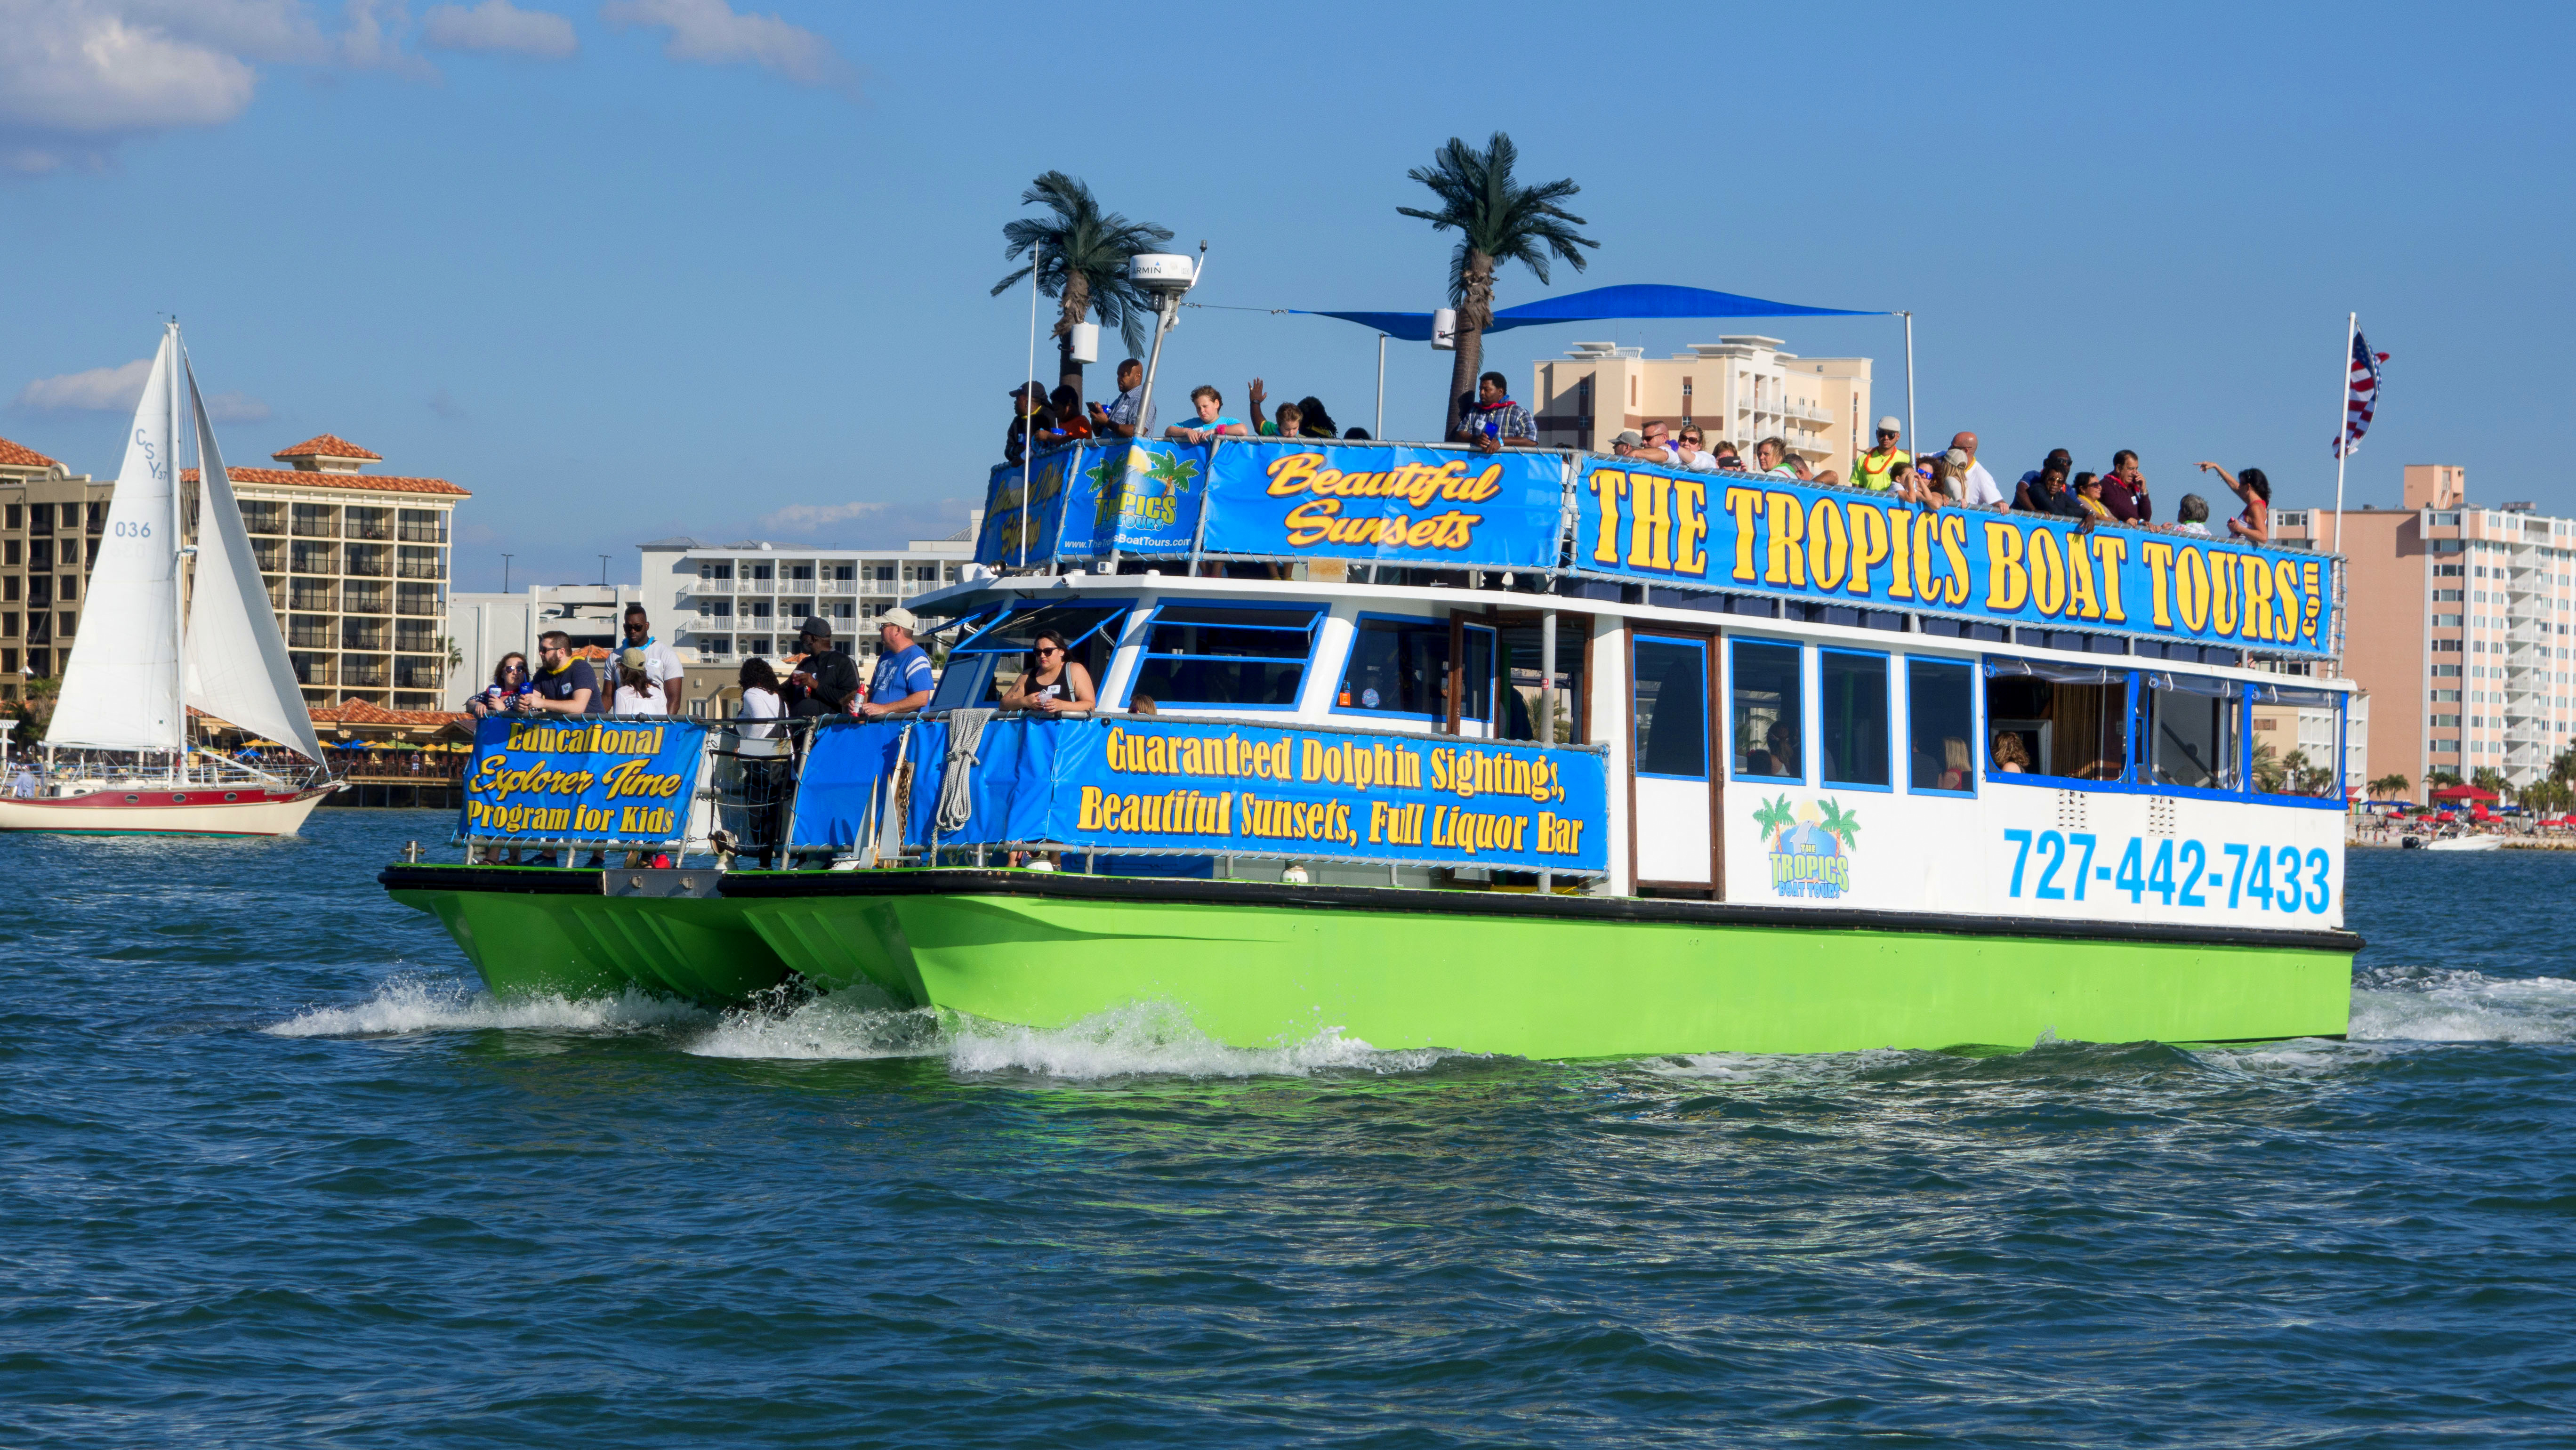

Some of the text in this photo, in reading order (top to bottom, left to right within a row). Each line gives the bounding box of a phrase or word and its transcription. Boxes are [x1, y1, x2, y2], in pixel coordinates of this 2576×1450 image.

[1266, 452, 1503, 508] Beautiful
[115, 521, 151, 538] 036
[1064, 533, 1192, 548] www.TheTrosBoatTours.com
[1117, 514, 1163, 531] TOURS
[1284, 498, 1484, 549] Sunsets
[1589, 468, 1708, 576] THE
[1725, 487, 1971, 606] TROPICS
[1984, 521, 2127, 622] BOAT
[2142, 542, 2300, 644] TOURS
[506, 722, 664, 754] Educational
[469, 755, 682, 801] Explorer Time
[1106, 726, 1565, 803] Guaranteed Dolphin Sightings,
[467, 800, 675, 833] Program for Kids
[1077, 786, 1584, 854] Beautiful Sunsets, Full Liquor Bar
[1801, 844, 1816, 853] THE
[1769, 852, 1849, 893] TROPICS
[1778, 881, 1841, 898] BOAT TOURS
[2004, 829, 2330, 915] 727-442-7433
